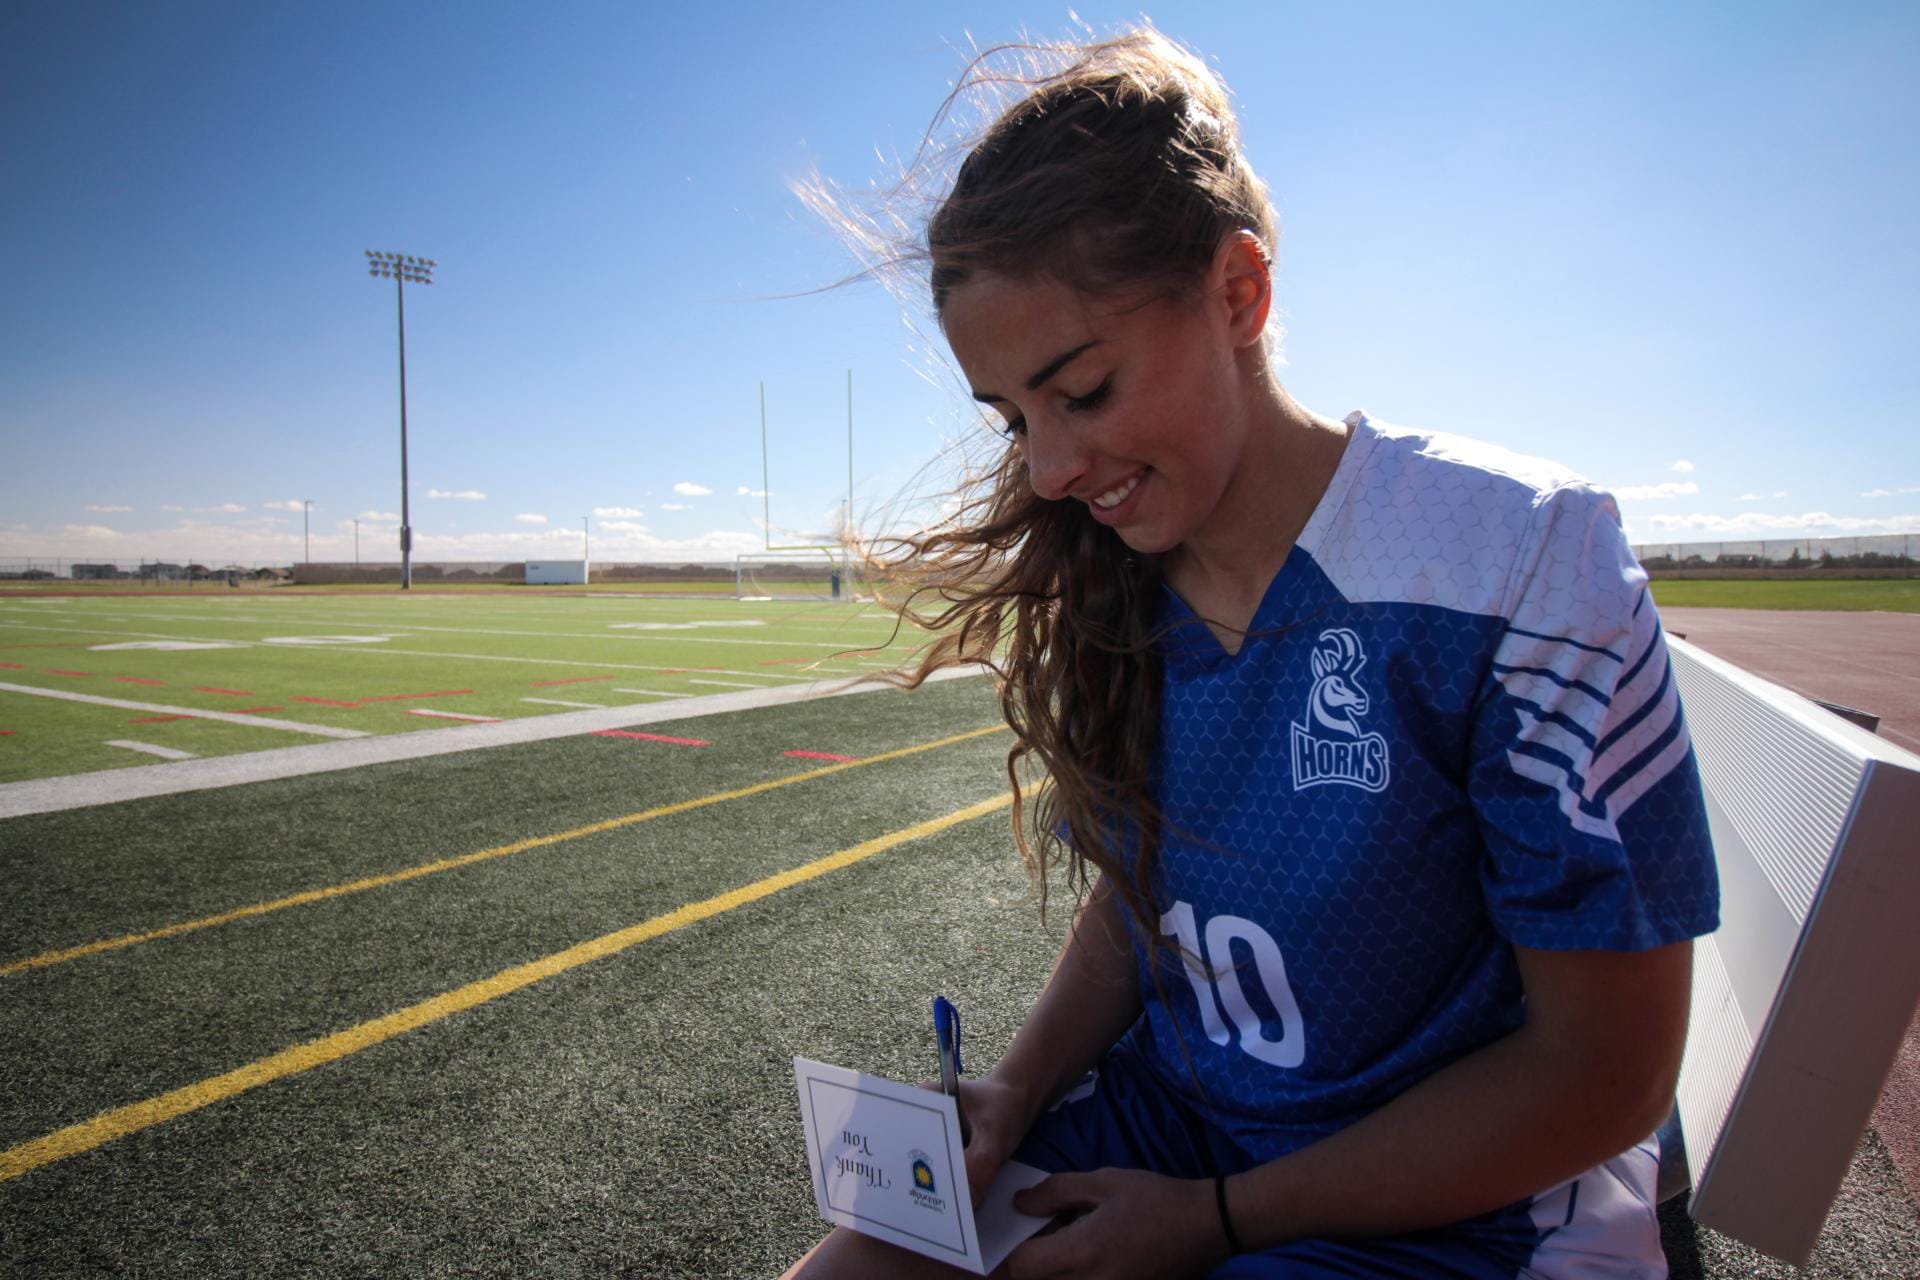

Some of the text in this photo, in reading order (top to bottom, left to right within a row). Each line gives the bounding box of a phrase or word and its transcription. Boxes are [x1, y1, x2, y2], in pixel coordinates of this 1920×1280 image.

[1296, 731, 1384, 787] HORNS
[1159, 900, 1306, 1069] 10
[842, 1130, 873, 1157] You
[835, 1155, 891, 1189] Thank
